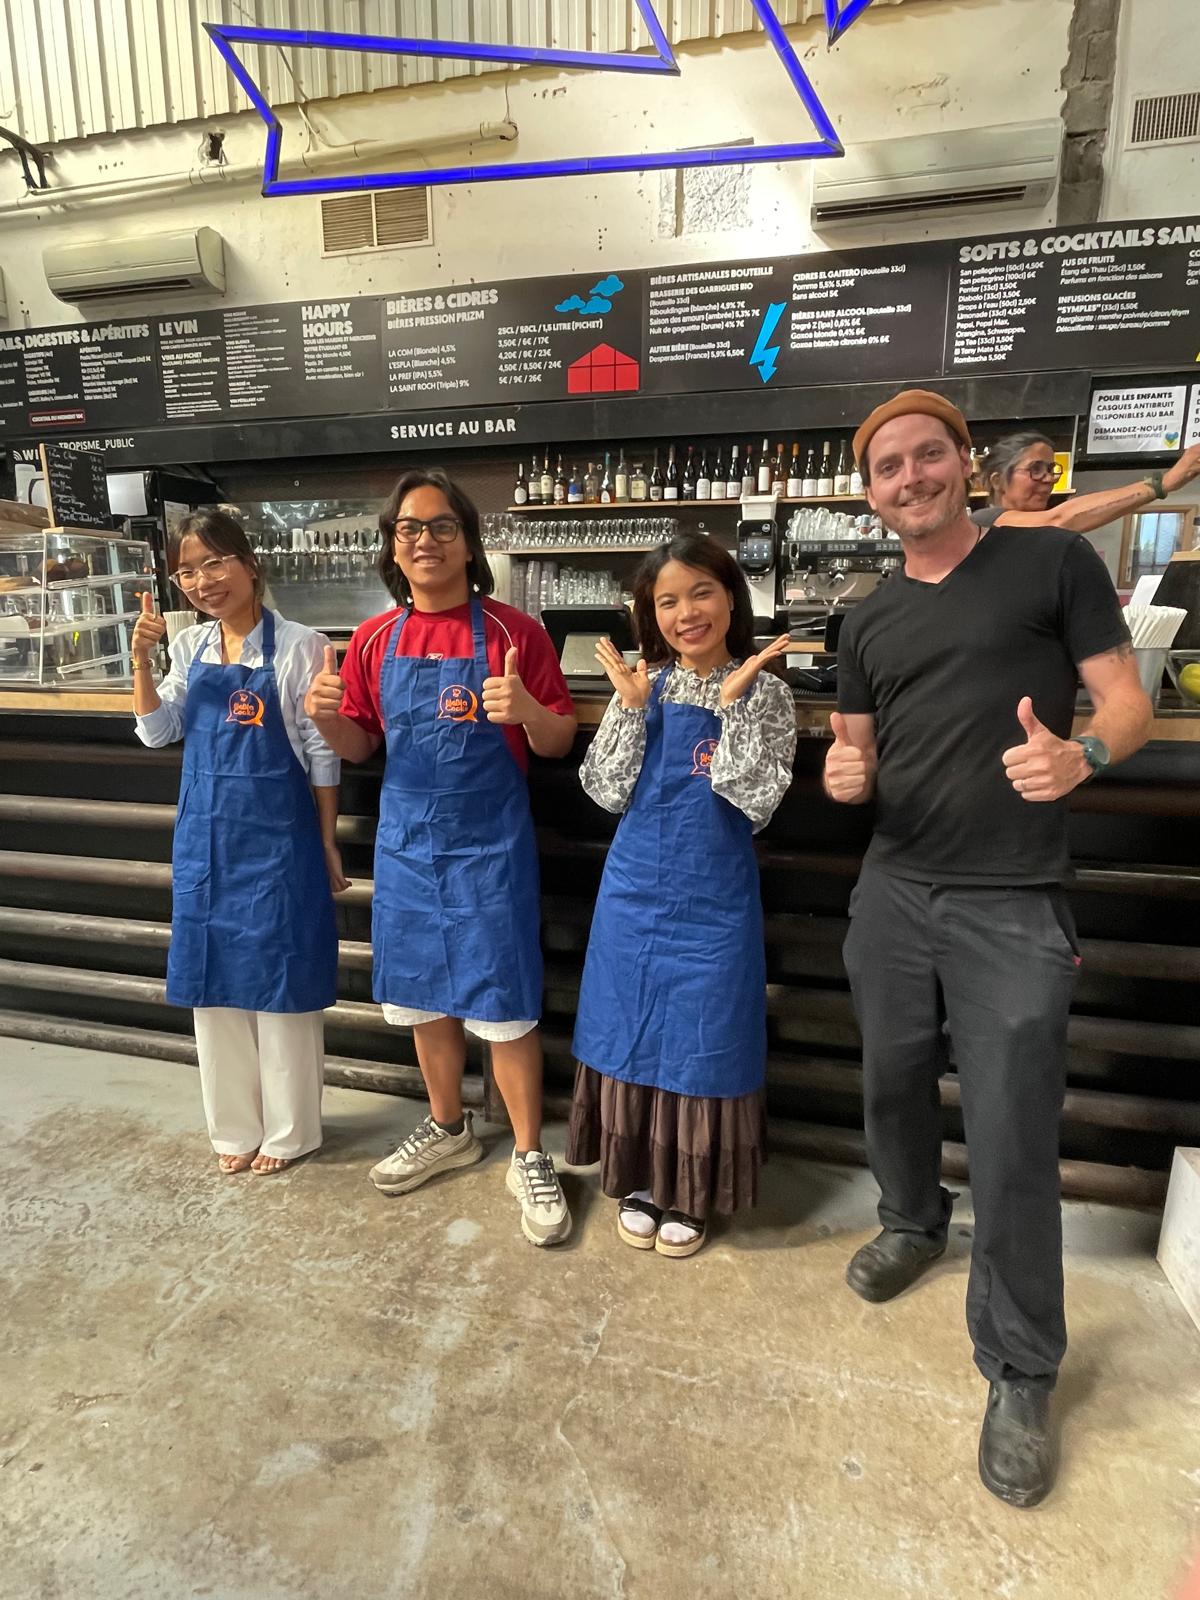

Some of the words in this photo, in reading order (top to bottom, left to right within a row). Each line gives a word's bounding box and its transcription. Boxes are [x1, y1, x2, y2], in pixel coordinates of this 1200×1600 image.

[959, 241, 1020, 263] SOFTS
[1023, 239, 1038, 256] &
[1041, 228, 1155, 254] COCKTAILS
[1157, 225, 1200, 246] SAN
[1062, 258, 1076, 267] JUS
[1088, 255, 1115, 264] FRUITS
[650, 275, 675, 285] BIÈRES
[677, 270, 729, 283] ARTISANALES
[731, 266, 773, 278] BOUTEILLE
[793, 272, 818, 281] CIDRES
[819, 271, 827, 279] EL
[828, 268, 860, 278] GAITERO
[973, 266, 1005, 276] pellegrino
[1060, 276, 1086, 284] Parfums
[1098, 274, 1124, 282] fonction
[1139, 272, 1162, 280] saisons
[650, 288, 684, 298] BRASSERIE
[686, 287, 698, 295] DES
[699, 284, 739, 293] GARRIGUES
[793, 283, 818, 291] Pomme
[793, 292, 807, 300] Sans
[809, 291, 828, 299] alcool
[1058, 293, 1101, 304] INFUSIONS
[1102, 291, 1136, 300] GLACÉES
[387, 296, 432, 315] BIÈRES
[434, 295, 445, 309] &
[447, 289, 498, 308] CIDRES
[302, 303, 350, 320] HAPPY
[691, 303, 719, 313] (blanche)
[816, 310, 835, 318] SANS
[836, 308, 866, 317] ALCOOL
[388, 318, 413, 329] BIÈRES
[415, 314, 455, 326] PRESSION
[457, 310, 484, 322] PRIZM
[650, 317, 669, 325] Saison
[670, 315, 680, 323] des
[957, 312, 988, 320] Limonade
[159, 322, 172, 336] LE
[174, 320, 198, 334] VIN
[303, 321, 353, 337] HOURS
[498, 327, 514, 335] 25CL
[520, 325, 537, 333] 50CL
[553, 322, 571, 331] LITRE
[572, 318, 603, 331] (PICHET)
[650, 326, 662, 334] Nuit
[25, 330, 80, 348] DIGESTIFS
[81, 330, 90, 342] &
[92, 324, 150, 341] APÉRITIFS
[498, 339, 516, 348] 3,50€
[397, 348, 412, 356] COM
[414, 346, 440, 356] (Blonde)
[649, 345, 670, 354] AUTRE
[498, 351, 517, 360] 4,20€
[649, 353, 684, 362] Desperados
[685, 351, 710, 360] (France)
[412, 358, 440, 368] (Blanche)
[499, 364, 517, 372] 4,50€
[524, 362, 542, 371] 8,50€
[413, 370, 427, 379] (IPA)
[428, 370, 442, 378] 5,5%
[499, 376, 508, 384] 5€
[514, 375, 522, 383] 9€
[529, 374, 542, 382] 26€
[437, 380, 458, 390] (Triple)
[1134, 401, 1174, 409] ANTIBRUIT
[1096, 412, 1144, 420] DISPONIBLES
[391, 423, 453, 438] SERVICE
[458, 421, 480, 434] AU
[485, 418, 516, 433] BAR
[1095, 425, 1163, 434] DEMANDEZ-NOUS
[59, 438, 135, 450] TROPISME_PUBLIC
[23, 449, 39, 461] WI
